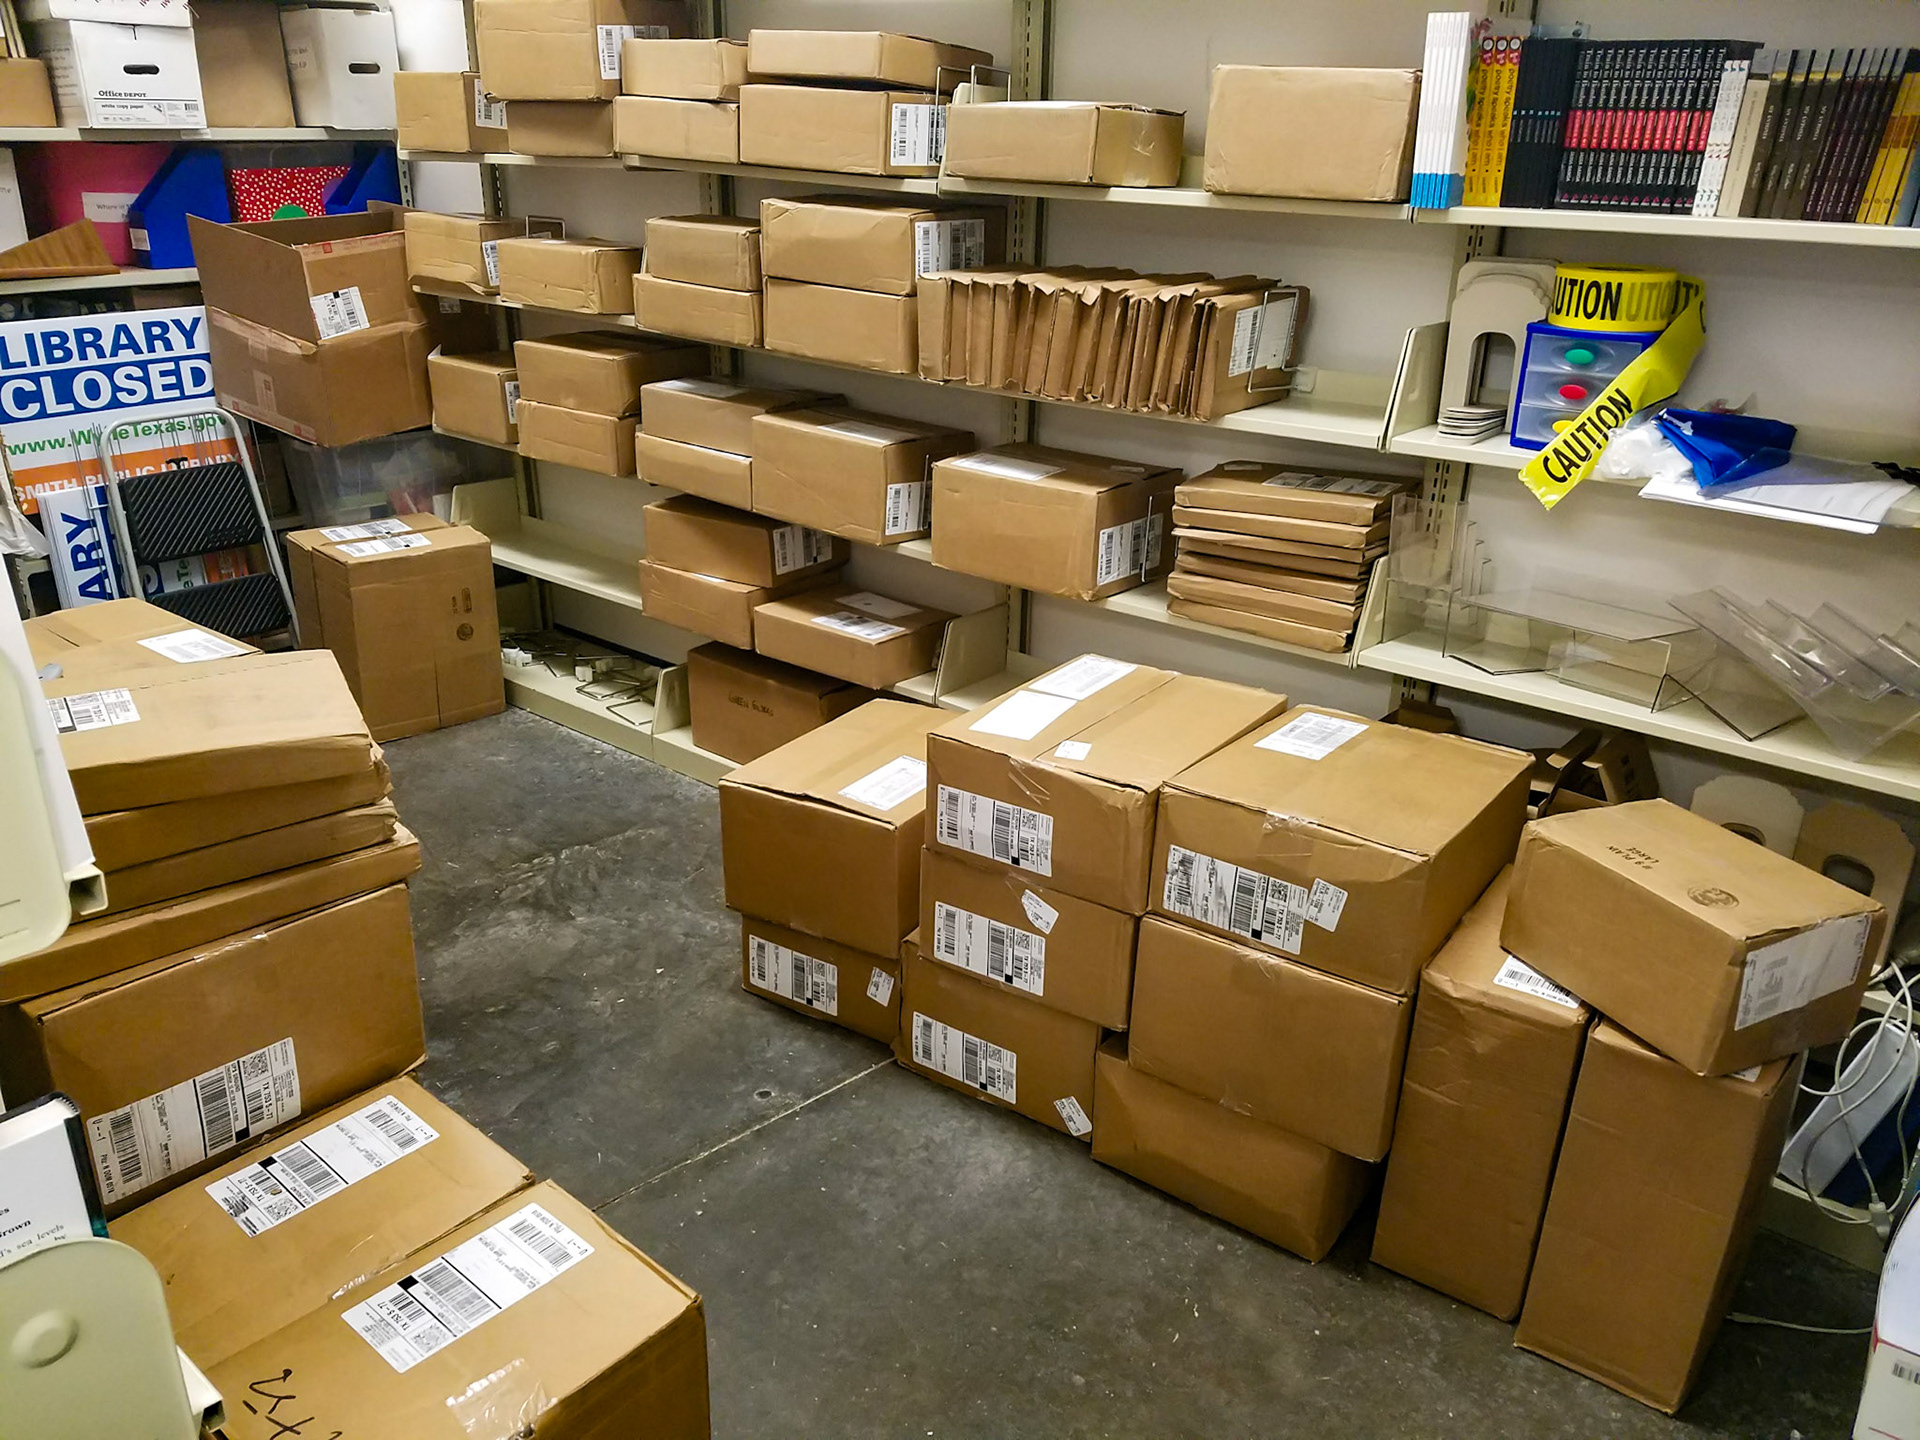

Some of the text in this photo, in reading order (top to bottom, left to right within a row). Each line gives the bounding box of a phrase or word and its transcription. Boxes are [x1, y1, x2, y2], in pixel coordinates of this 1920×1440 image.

[1478, 69, 1489, 94] poetry
[1491, 69, 1502, 94] poetry
[1504, 68, 1514, 94] poetry
[1474, 97, 1486, 127] speaks
[1488, 97, 1499, 128] speaks
[1500, 96, 1512, 127] speaks
[1472, 128, 1481, 146] who
[1485, 129, 1494, 146] who
[1498, 129, 1506, 147] who
[1551, 275, 1622, 320] UTION
[0, 317, 201, 370] LIBRARY
[0, 358, 214, 418] CLOSED
[1543, 388, 1633, 483] CAUTION
[262, 1081, 269, 1090] TX
[263, 1090, 271, 1103] 753
[16, 1238, 32, 1249] sea
[36, 1224, 64, 1240] levels
